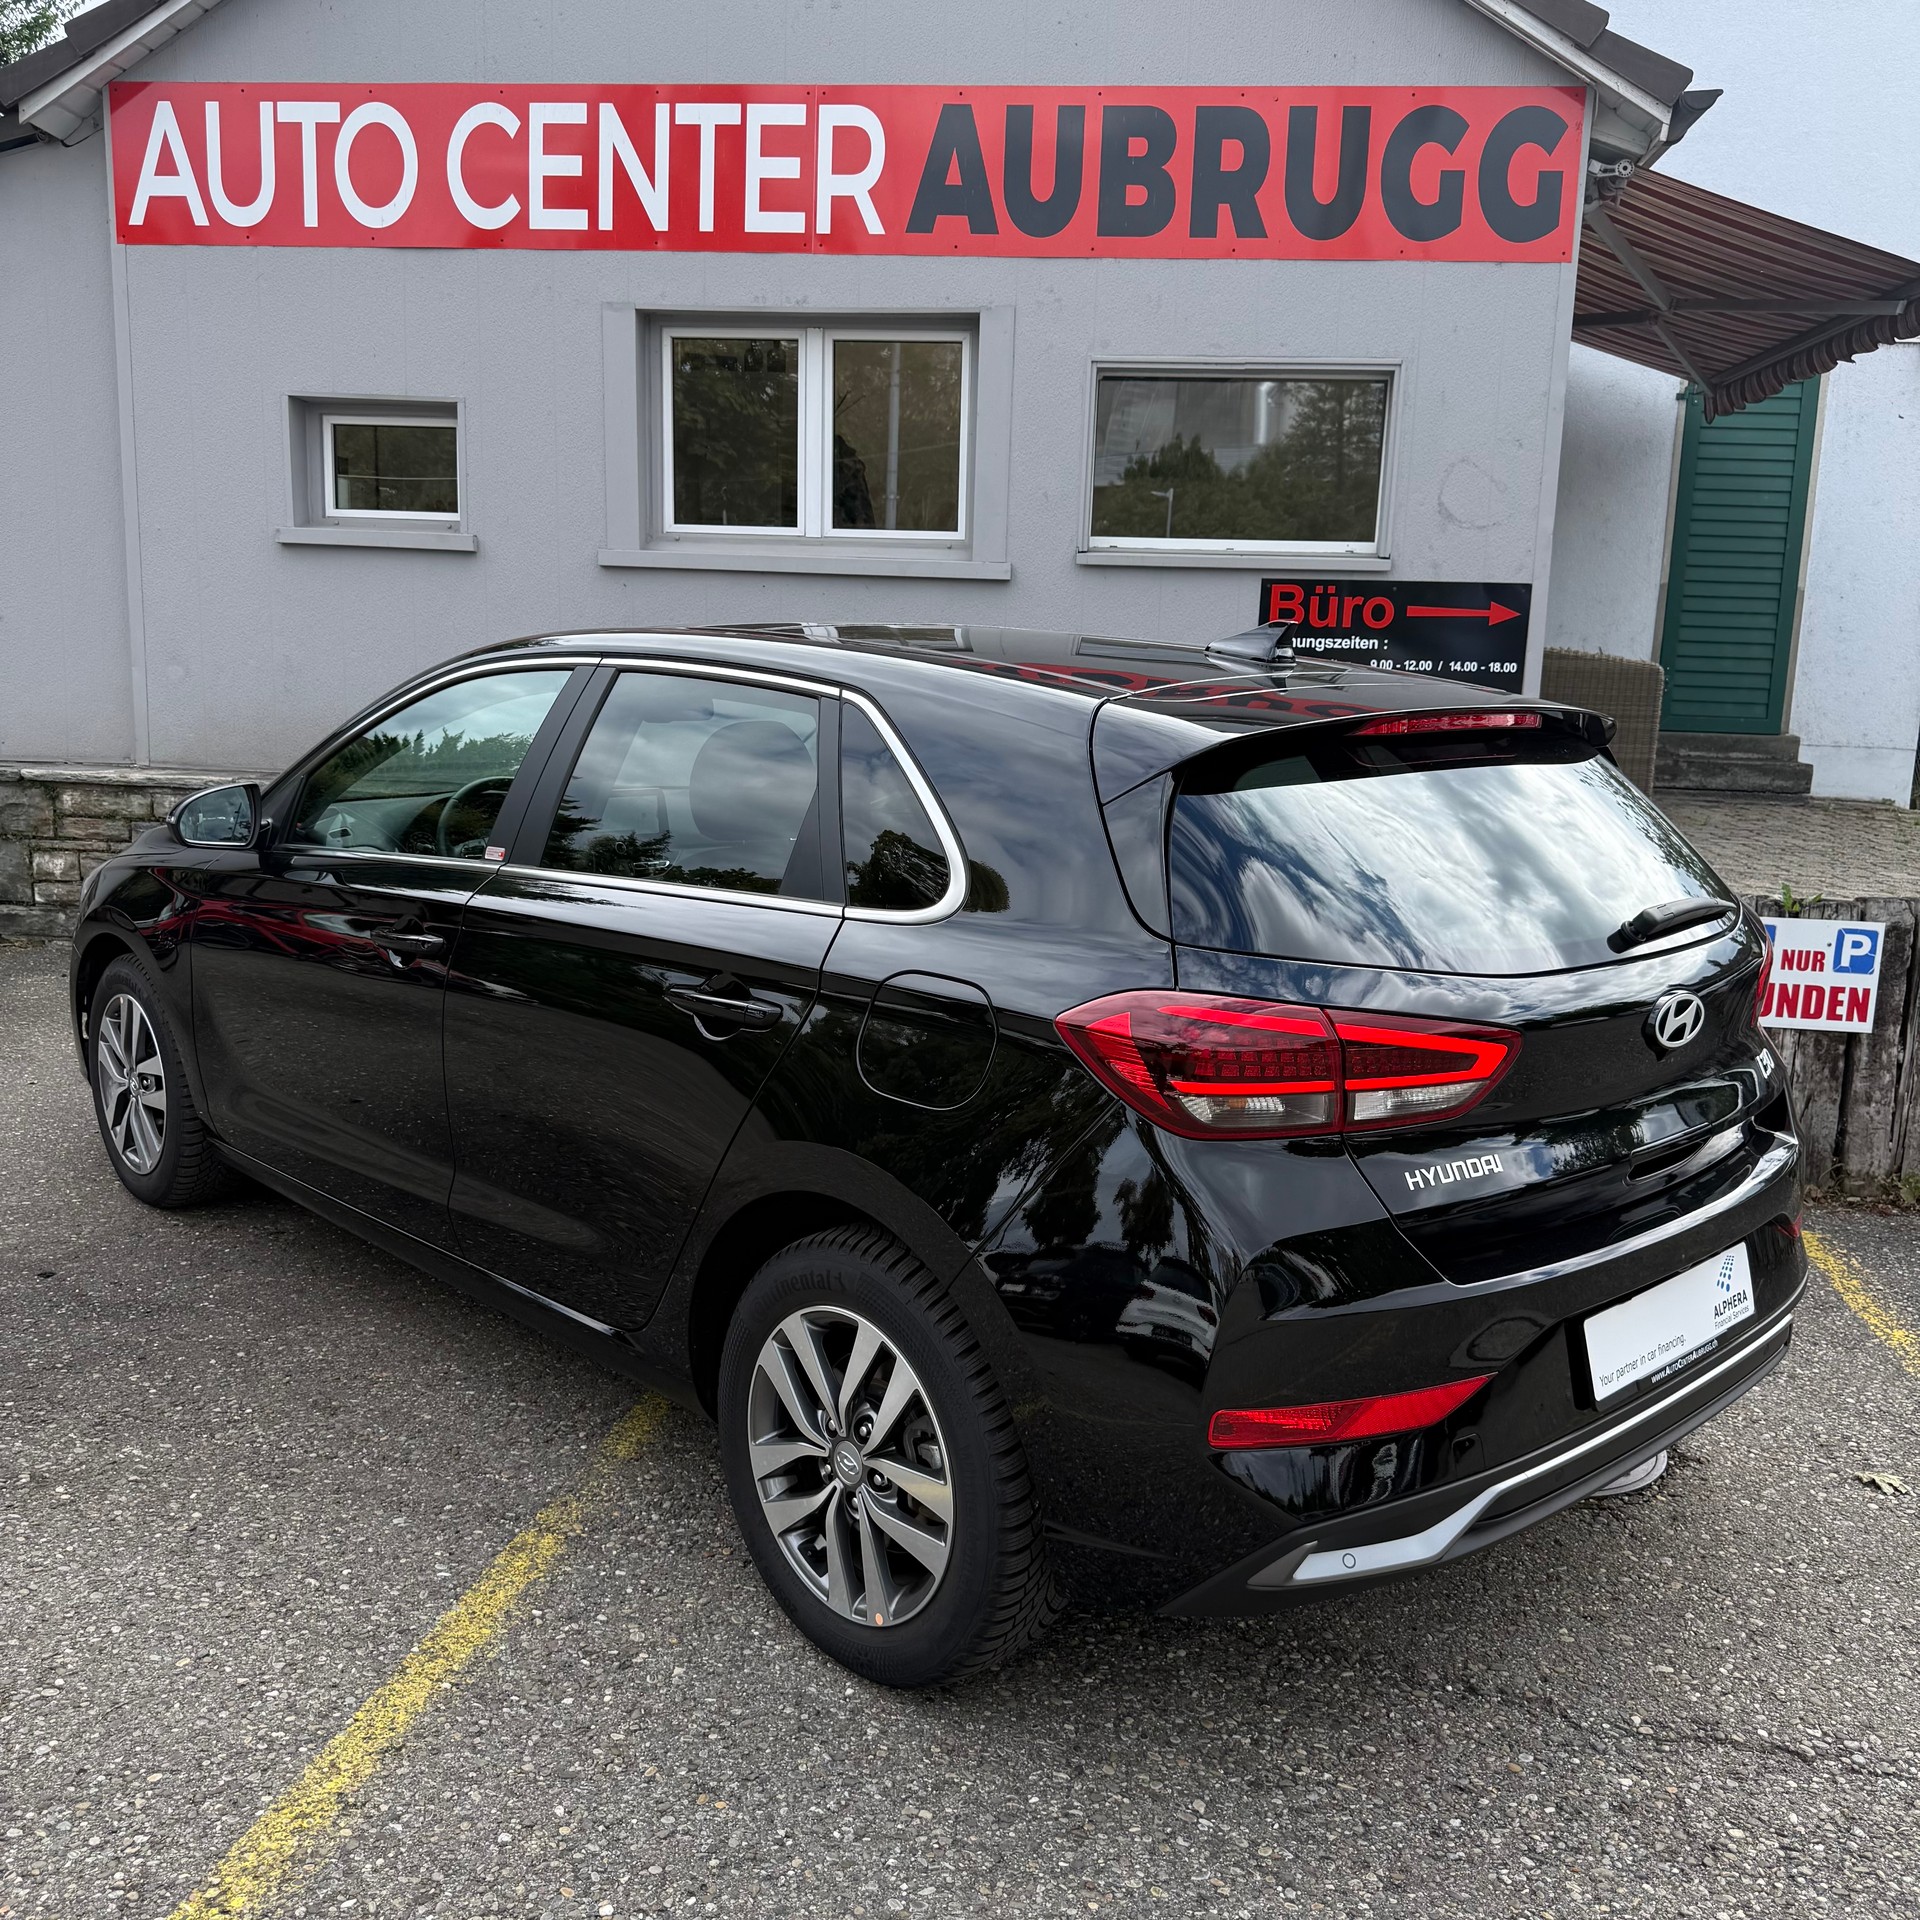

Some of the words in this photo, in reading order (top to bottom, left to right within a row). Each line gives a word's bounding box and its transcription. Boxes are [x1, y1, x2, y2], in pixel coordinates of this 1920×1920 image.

[129, 101, 419, 229] AUTO
[446, 102, 886, 235] CENTER
[905, 104, 1569, 243] AUBRUGG
[1269, 583, 1395, 629] Büro
[1292, 635, 1378, 652] ungszeiten
[1403, 660, 1433, 671] 12.00
[1449, 661, 1478, 672] 14.00
[1489, 662, 1518, 673] 18.00
[1780, 949, 1826, 972] NUR
[1758, 983, 1871, 1023] UNDEN
[1404, 1153, 1504, 1191] HYUNDAI
[1713, 1289, 1748, 1320] ALPHERA
[1732, 1304, 1750, 1320] Services
[1599, 1371, 1615, 1387] Your
[1615, 1358, 1639, 1381] partner
[1639, 1354, 1647, 1366] in
[1646, 1349, 1657, 1362] car
[1657, 1334, 1687, 1356] financing.
